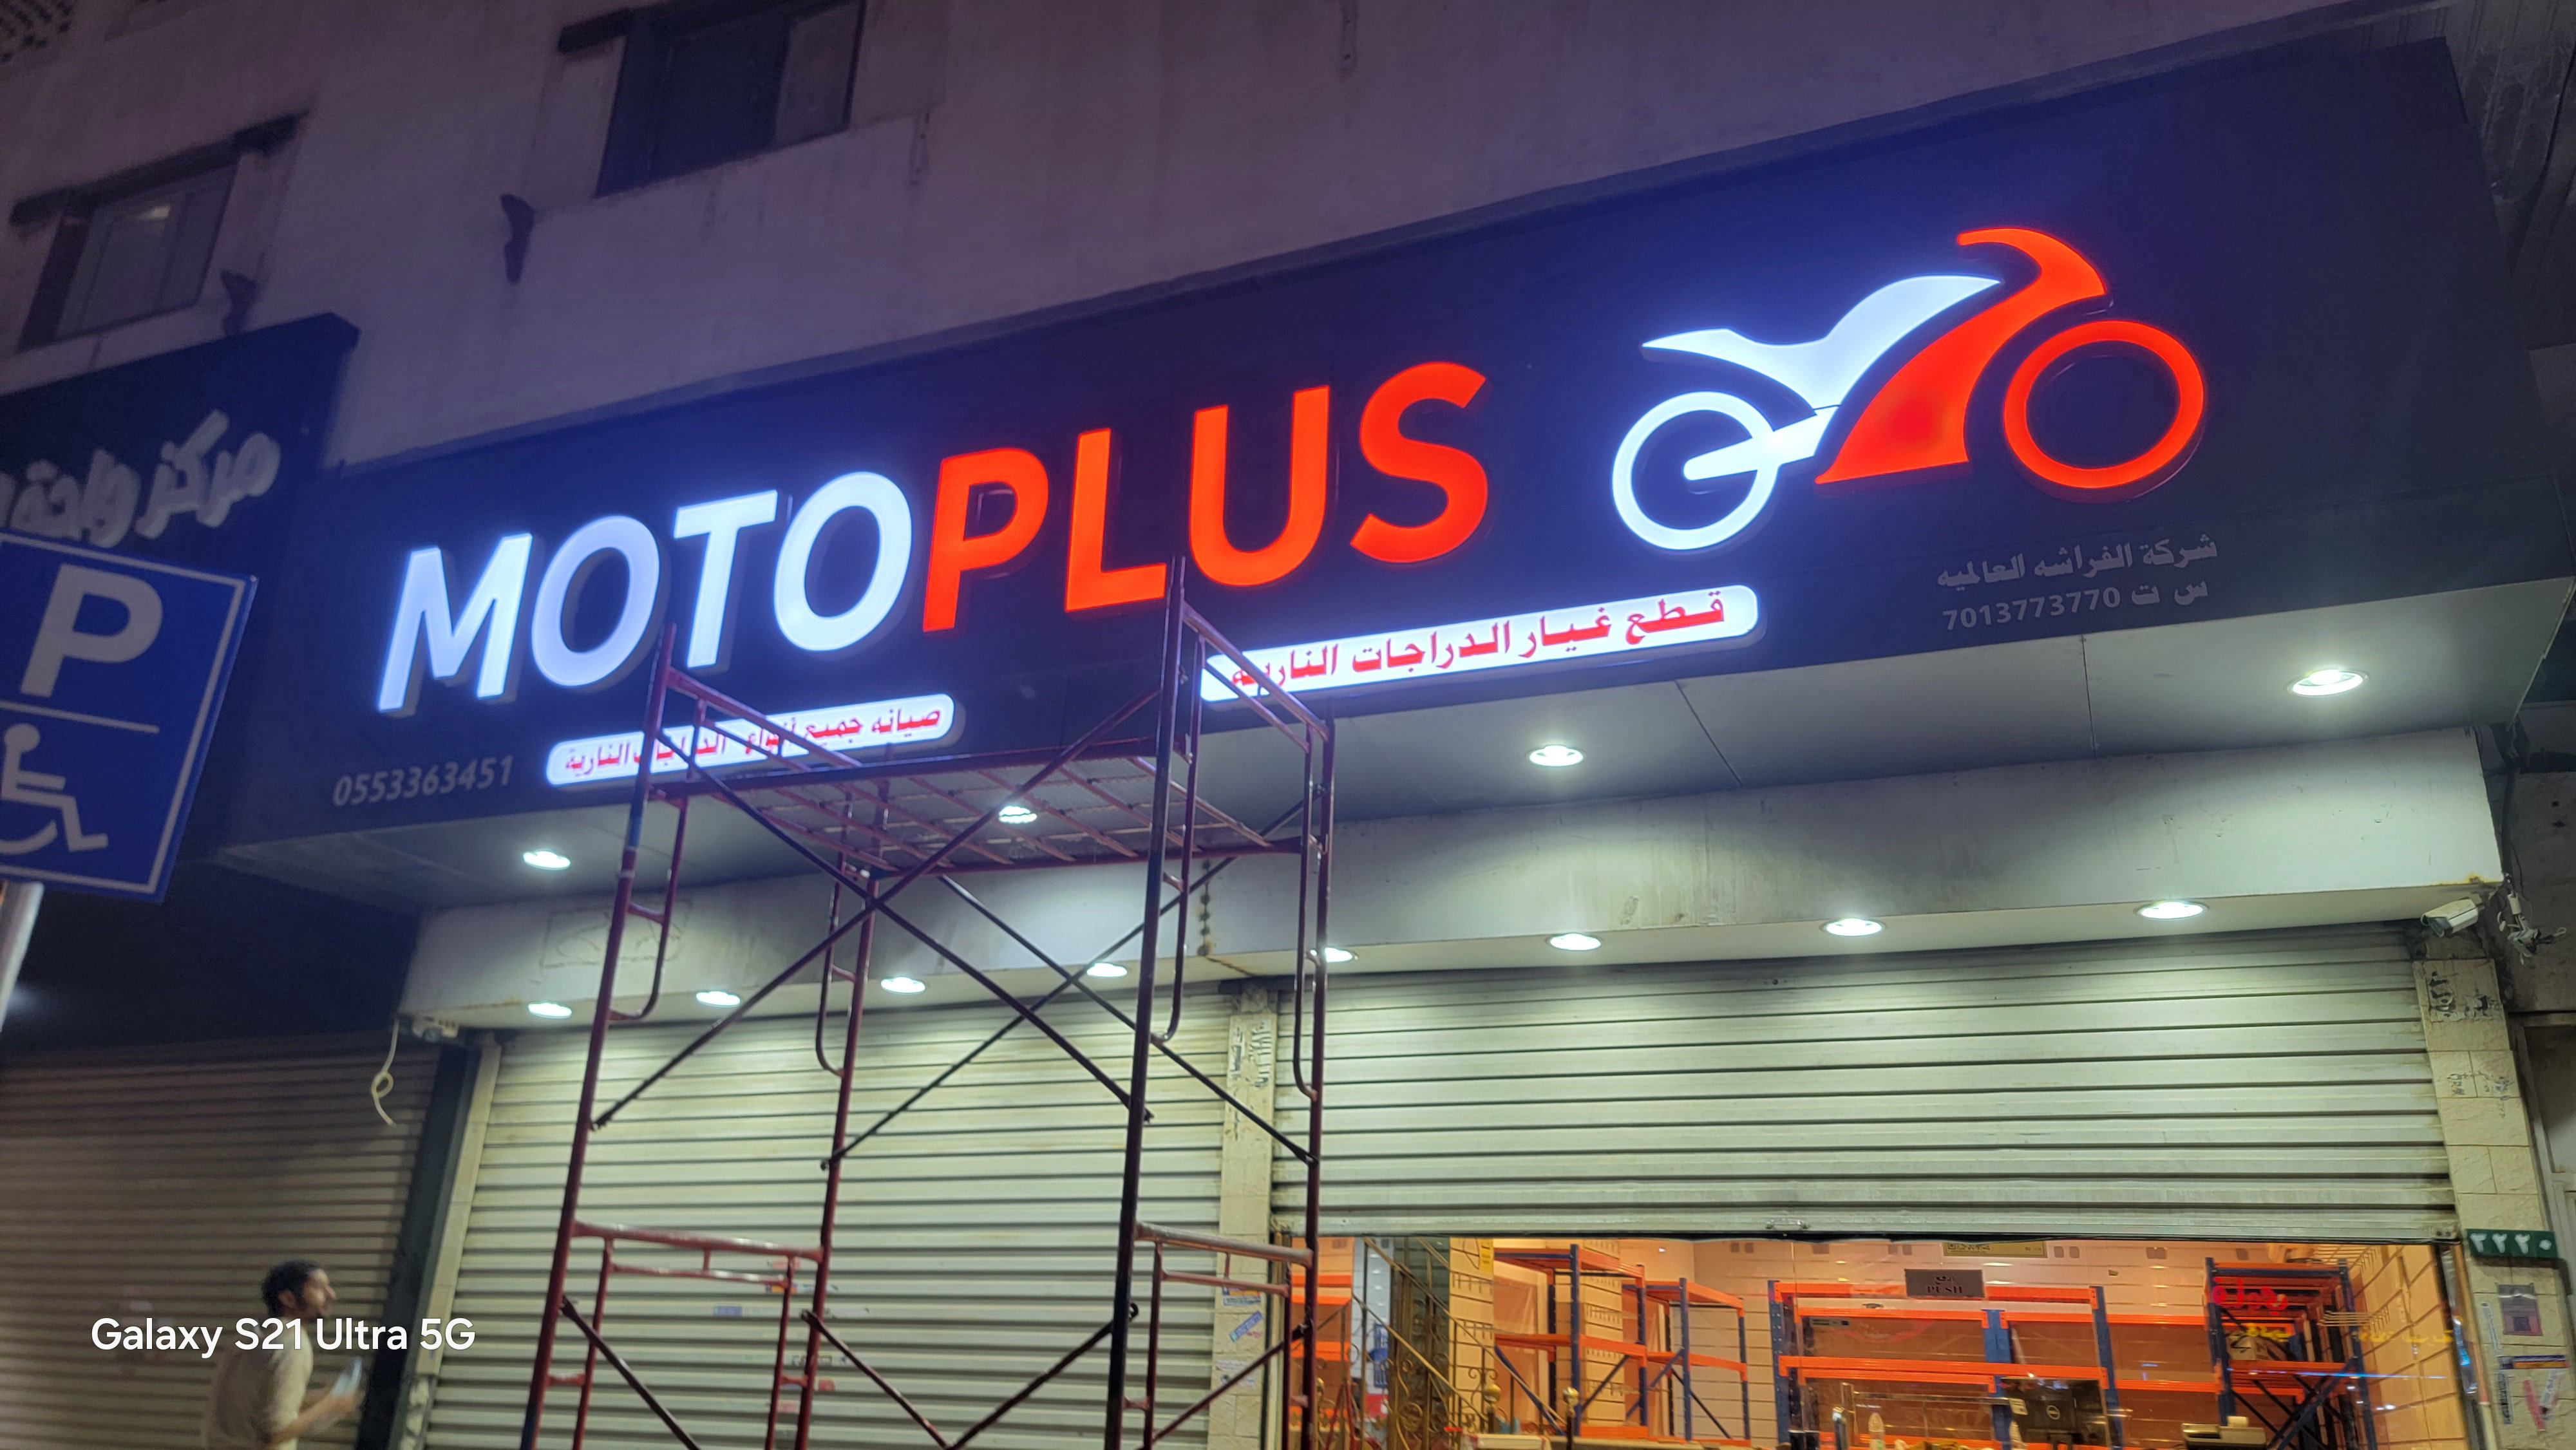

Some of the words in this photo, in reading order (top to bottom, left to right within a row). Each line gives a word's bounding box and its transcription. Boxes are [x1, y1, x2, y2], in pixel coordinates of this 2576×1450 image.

[134, 408, 281, 540] مركز
[2139, 533, 2218, 568] شركة
[1942, 587, 2121, 631] 7013773770
[2131, 585, 2160, 605] ت
[2174, 581, 2209, 606] س
[20, 563, 164, 698] P
[1518, 607, 1612, 658] غيار
[1625, 590, 1725, 645] قطع
[1352, 619, 1511, 673] الدراجات
[806, 718, 862, 748] جميع
[871, 708, 940, 738] صيانه
[332, 755, 514, 807] 0553363451
